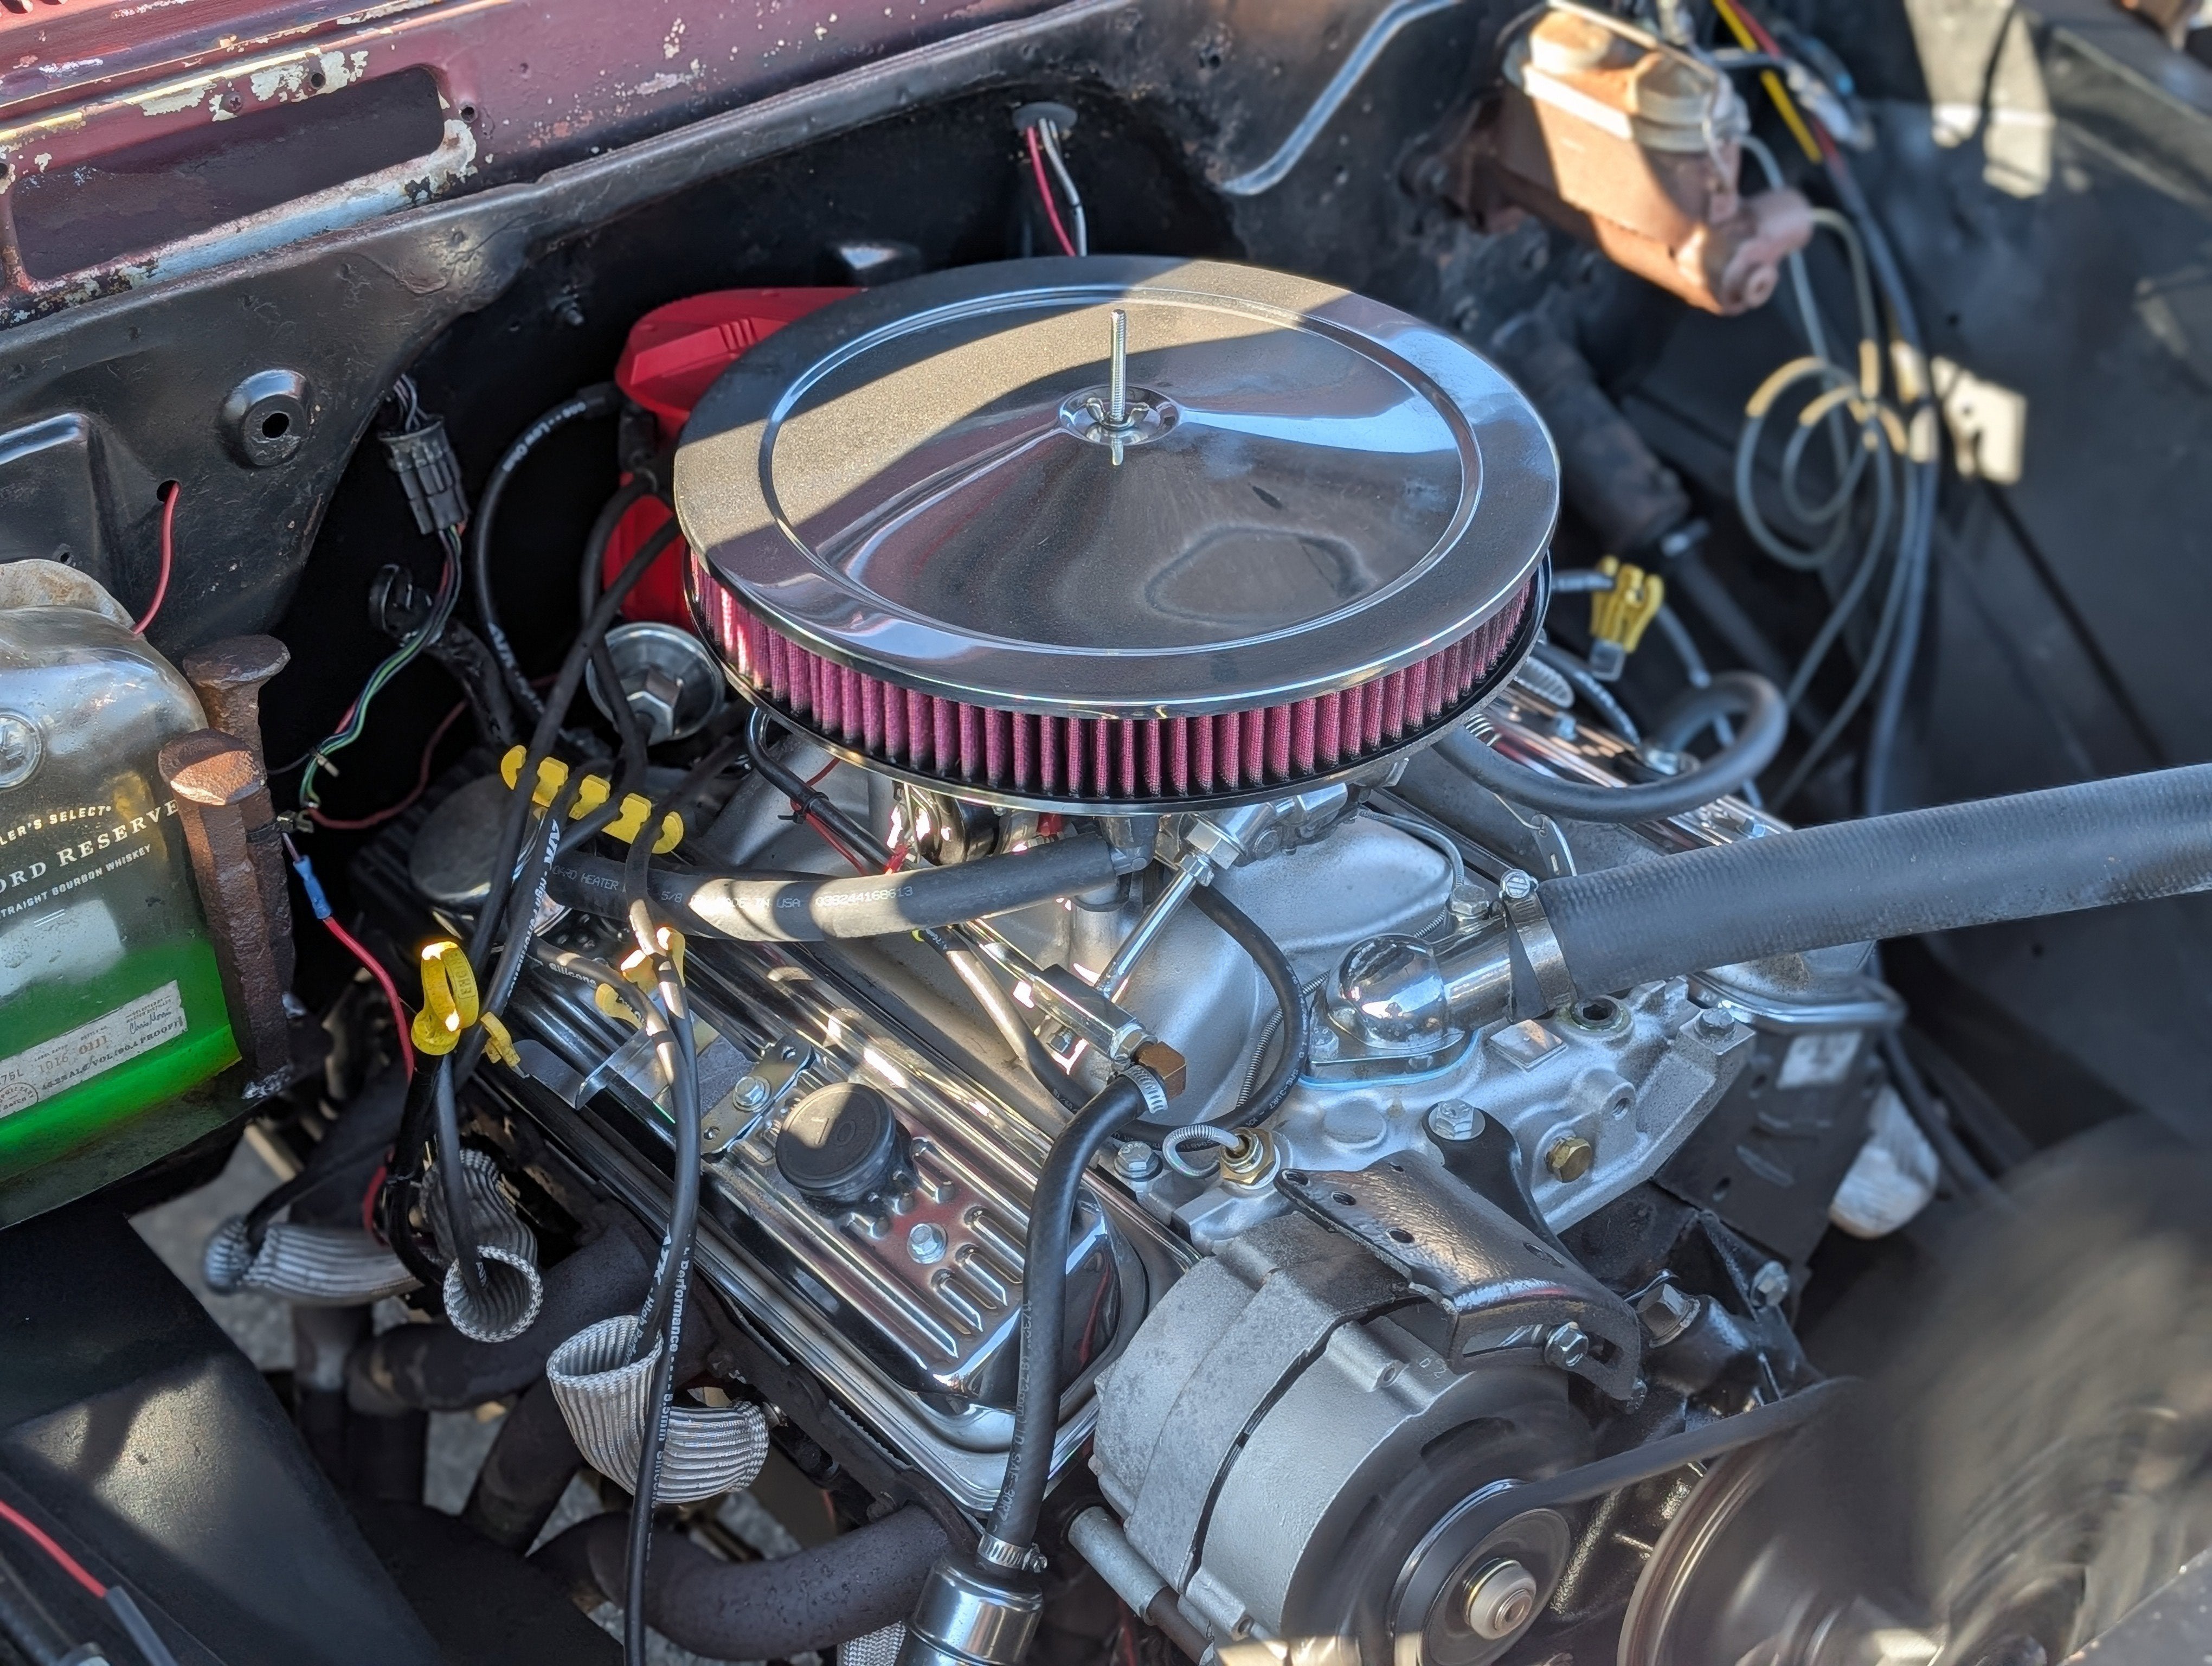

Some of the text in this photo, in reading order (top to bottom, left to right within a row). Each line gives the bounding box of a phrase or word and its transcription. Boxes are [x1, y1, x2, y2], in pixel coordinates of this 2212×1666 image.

[49, 805, 106, 824] SELECT
[56, 799, 179, 868] RESERVE
[0, 843, 151, 919] TRAIGHT BOURBON WHISKEY
[580, 873, 619, 890] HEATER
[660, 890, 683, 903] 5/8
[777, 898, 801, 908] USA
[668, 1259, 690, 1353] Performance
[996, 1452, 1022, 1522] SAE-30R7
